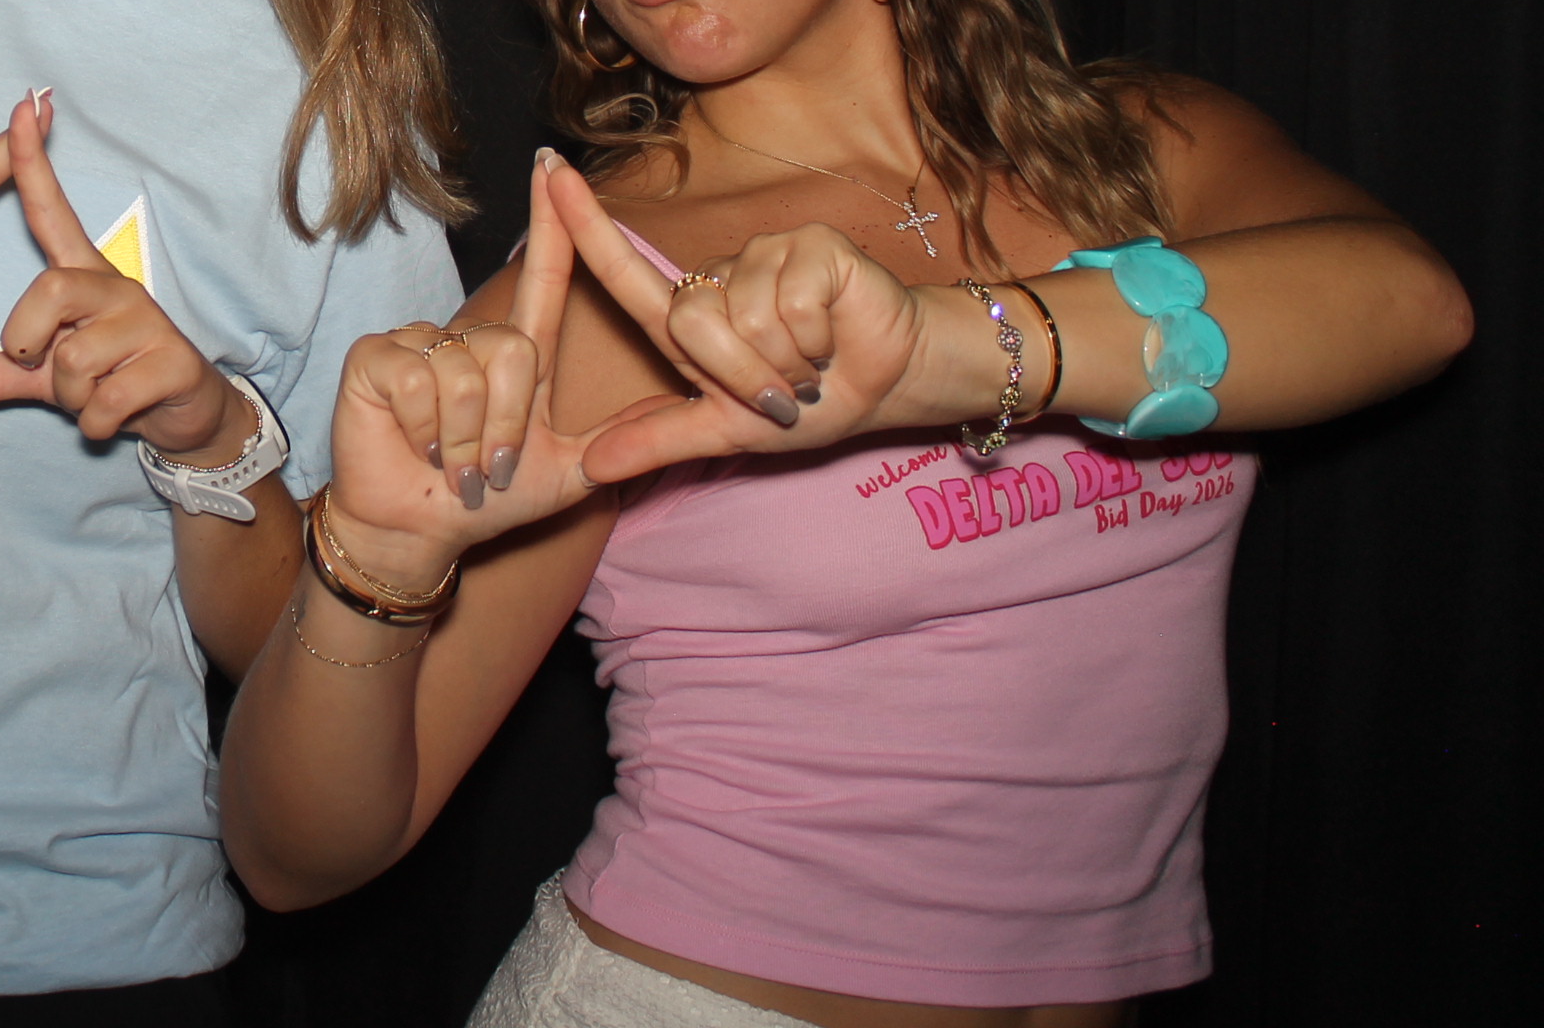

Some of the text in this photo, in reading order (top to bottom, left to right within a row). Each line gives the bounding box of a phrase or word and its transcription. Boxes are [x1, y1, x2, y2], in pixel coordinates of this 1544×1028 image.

[856, 446, 947, 498] welcome
[905, 462, 1061, 551] DELTA
[1063, 446, 1142, 509] DEL
[1094, 471, 1234, 534] Bid Day 2026
